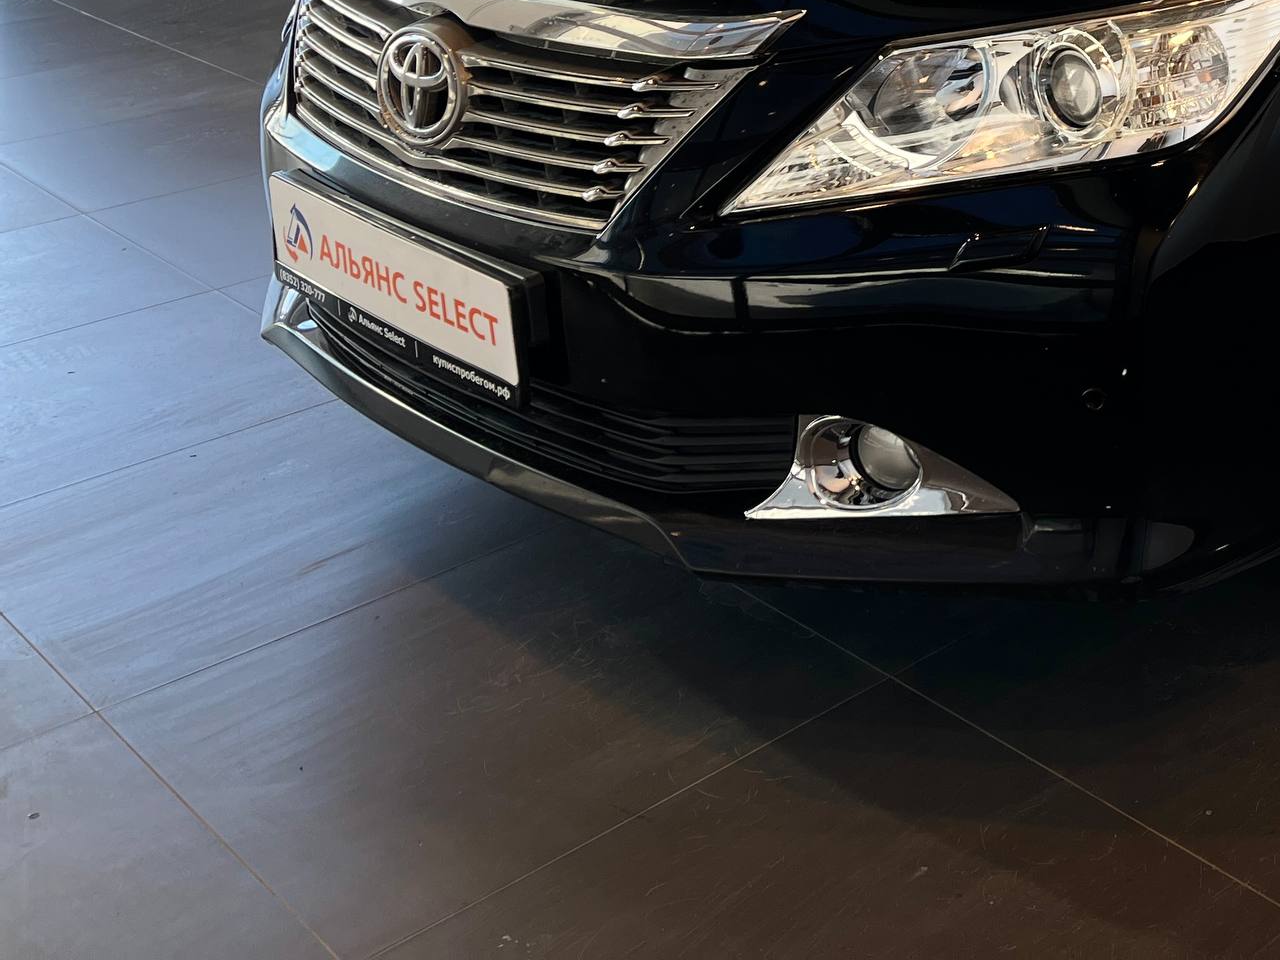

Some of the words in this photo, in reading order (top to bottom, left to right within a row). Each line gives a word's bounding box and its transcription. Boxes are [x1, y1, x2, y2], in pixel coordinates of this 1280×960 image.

[279, 268, 300, 290] (8352)
[300, 281, 325, 303] 320-777
[319, 234, 408, 305] АЛЬЯНС
[413, 280, 498, 346] SELECT
[358, 313, 383, 336] Альянс
[383, 327, 407, 348] Select
[432, 354, 512, 401] куписпробегом.рф
